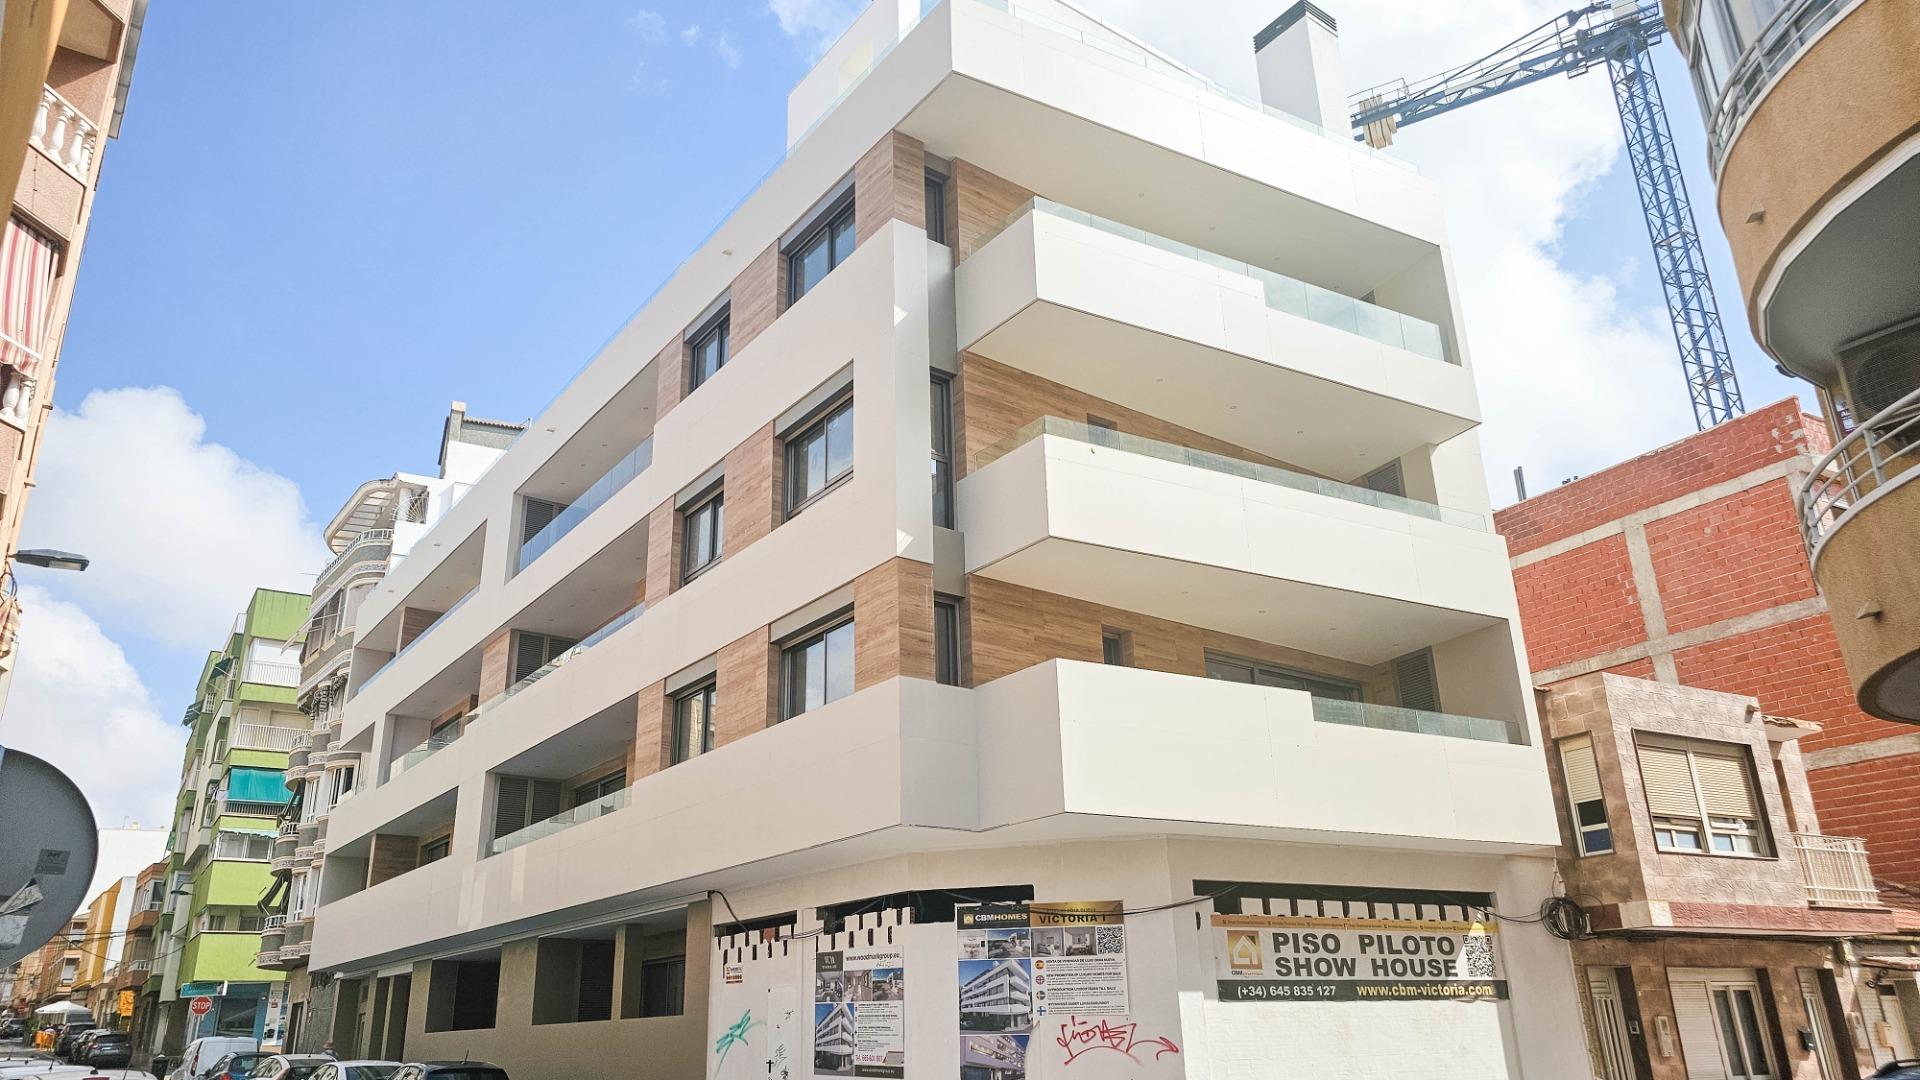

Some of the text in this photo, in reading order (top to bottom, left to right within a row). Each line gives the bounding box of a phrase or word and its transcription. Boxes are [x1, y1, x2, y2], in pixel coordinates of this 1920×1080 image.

[975, 913, 1028, 922] CBMHOMES
[1039, 914, 1098, 924] VICTORIA
[1272, 932, 1455, 956] PISO PILOTO
[1275, 956, 1458, 977] SHOW HOUSE
[1237, 982, 1493, 998] (+34) 645 835 127 www.cbm-victoria.com
[192, 1001, 210, 1010] STOP
